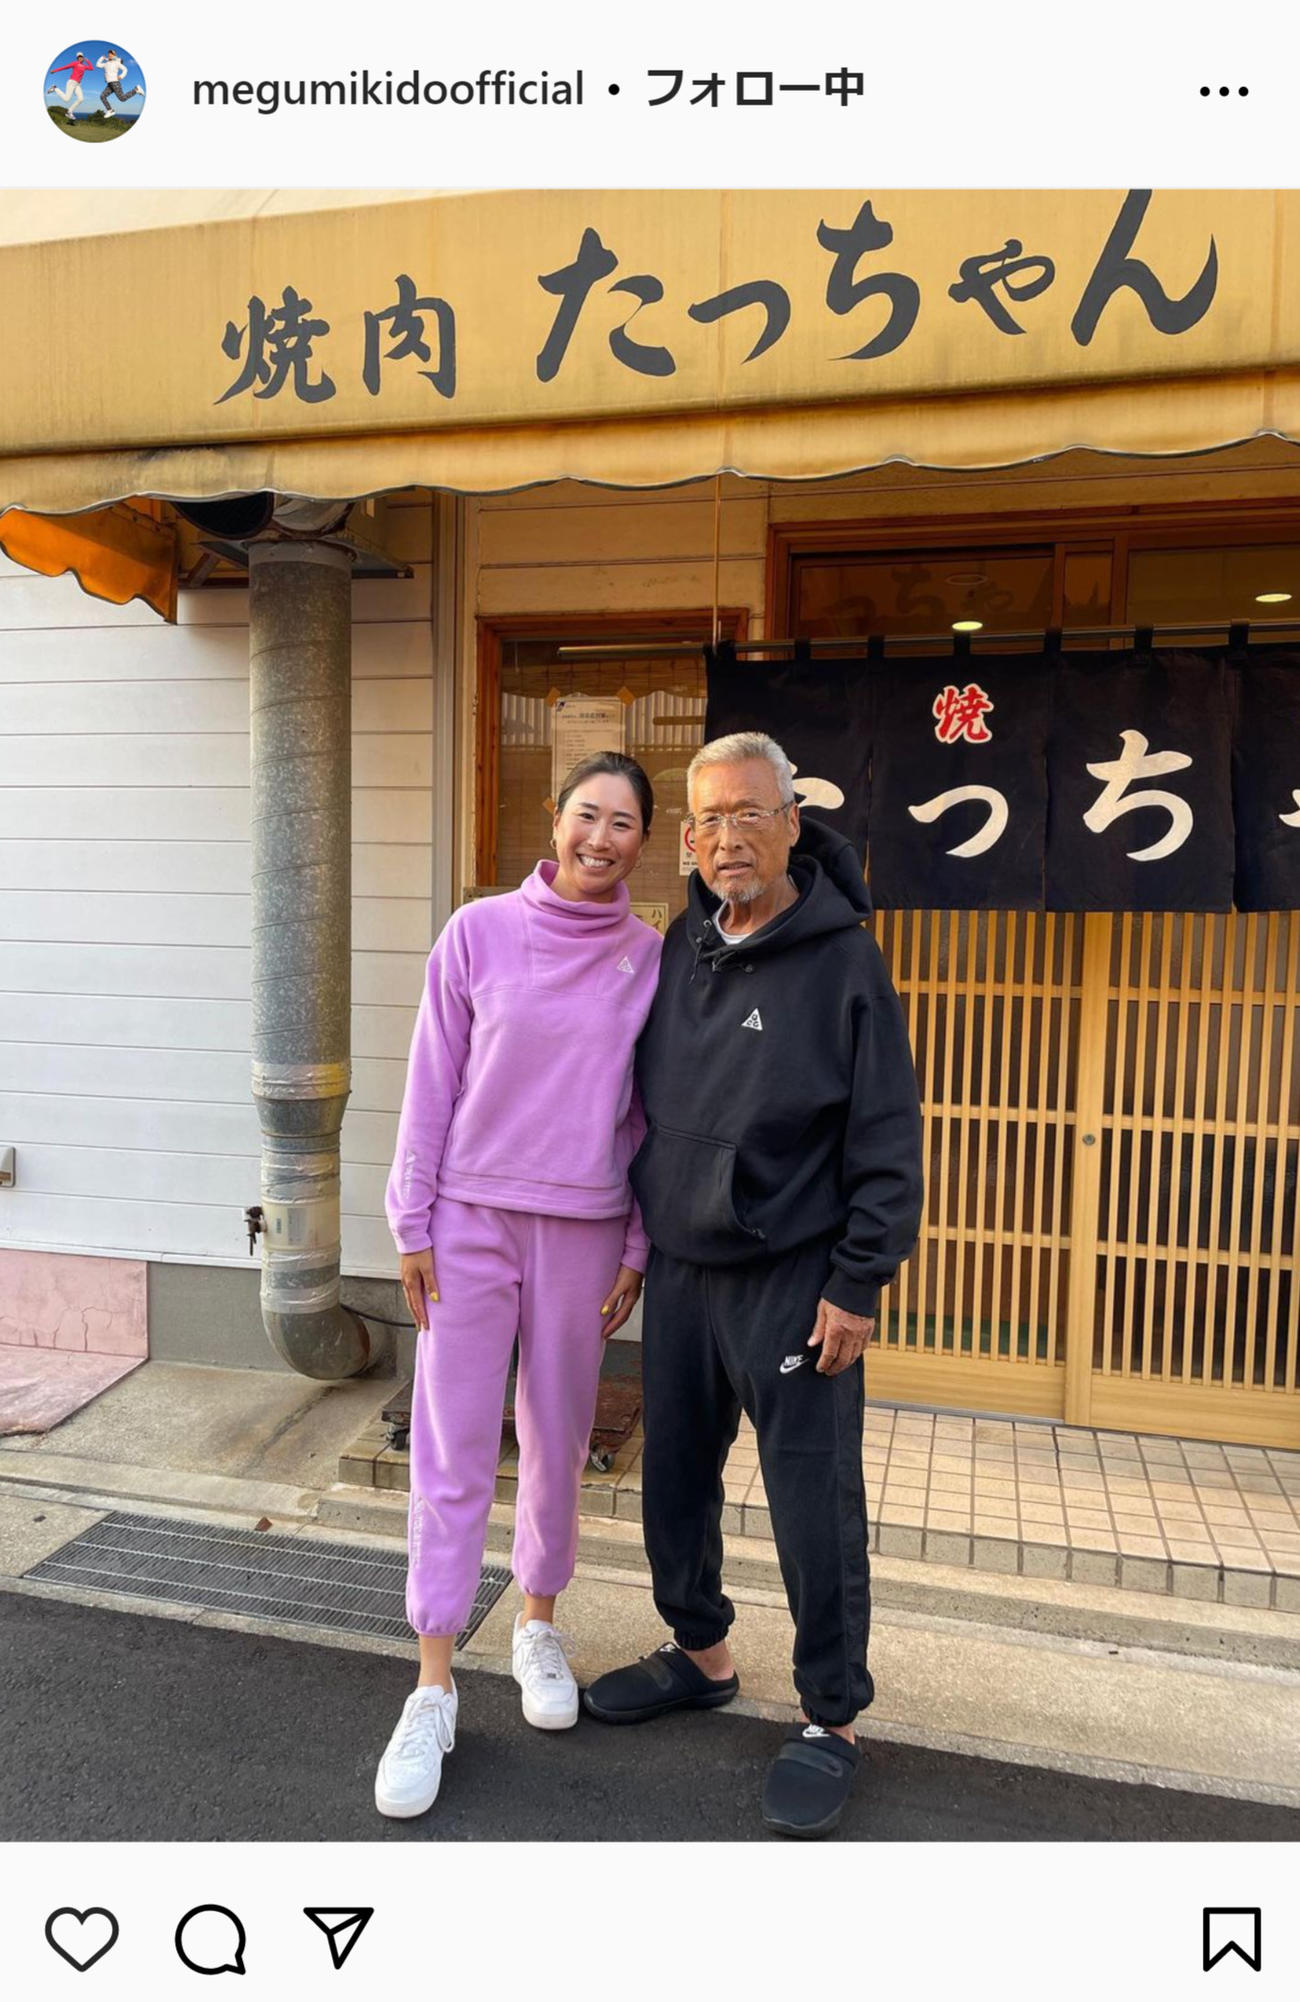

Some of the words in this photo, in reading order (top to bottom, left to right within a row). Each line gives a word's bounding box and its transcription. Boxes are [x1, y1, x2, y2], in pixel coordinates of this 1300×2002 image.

[213, 274, 457, 405] 焼肉
[536, 188, 1219, 383] たっちゃん
[931, 682, 995, 745] 焼
[783, 1354, 804, 1367] NIKE
